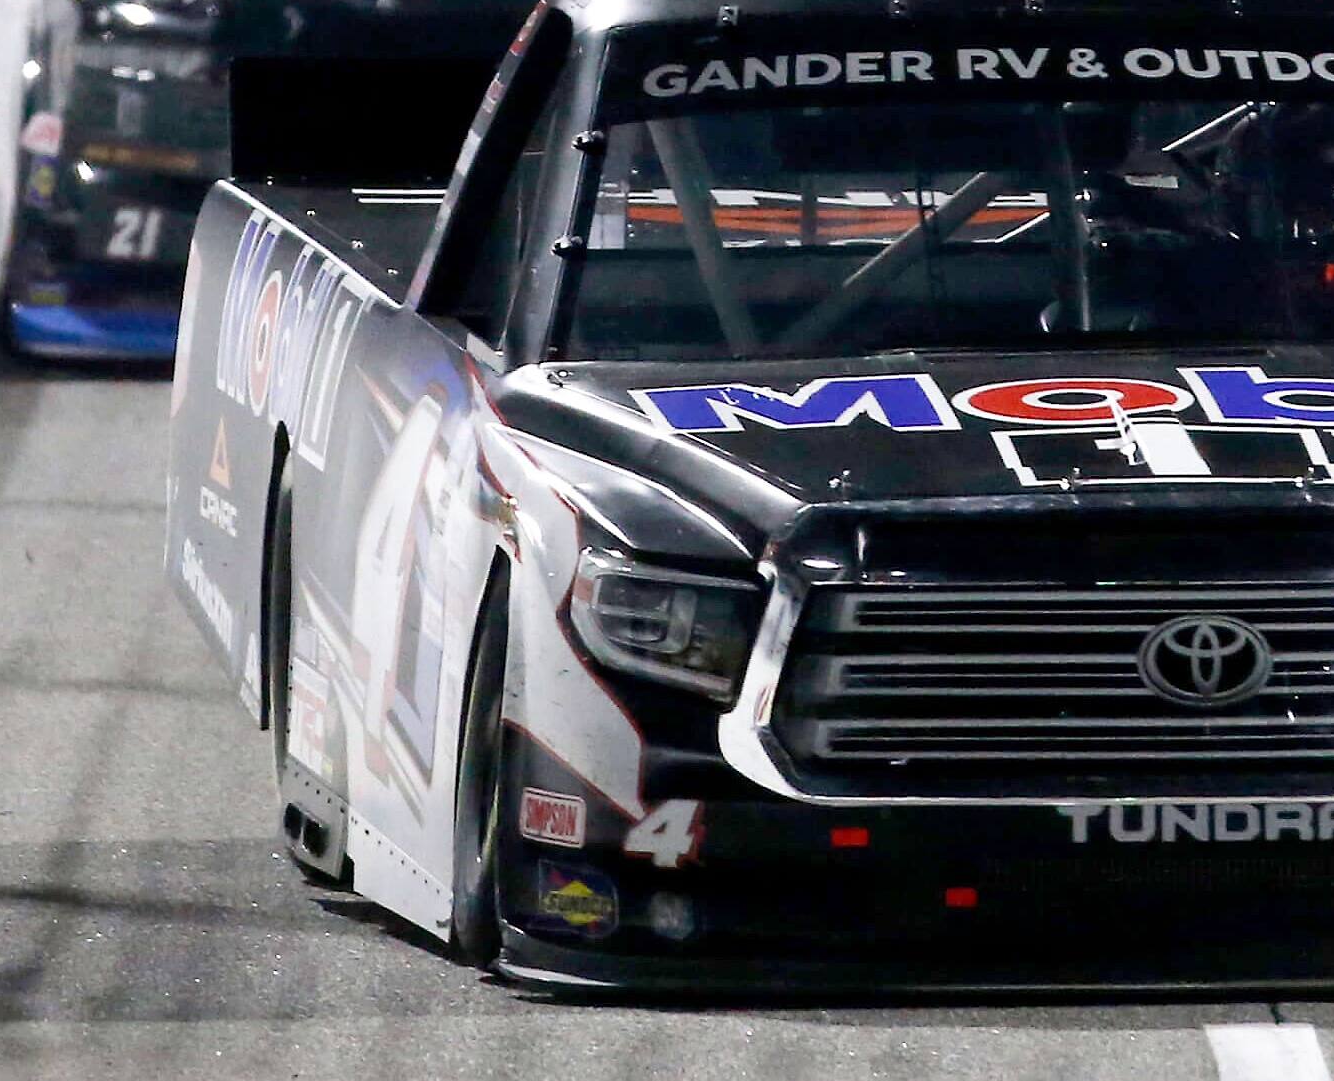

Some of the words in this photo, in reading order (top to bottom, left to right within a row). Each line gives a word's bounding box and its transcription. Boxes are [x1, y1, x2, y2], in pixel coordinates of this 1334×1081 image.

[642, 49, 935, 98] GANDER
[956, 47, 1050, 80] RV
[1066, 47, 1109, 79] &
[107, 207, 162, 258] 21
[622, 798, 705, 868] 4
